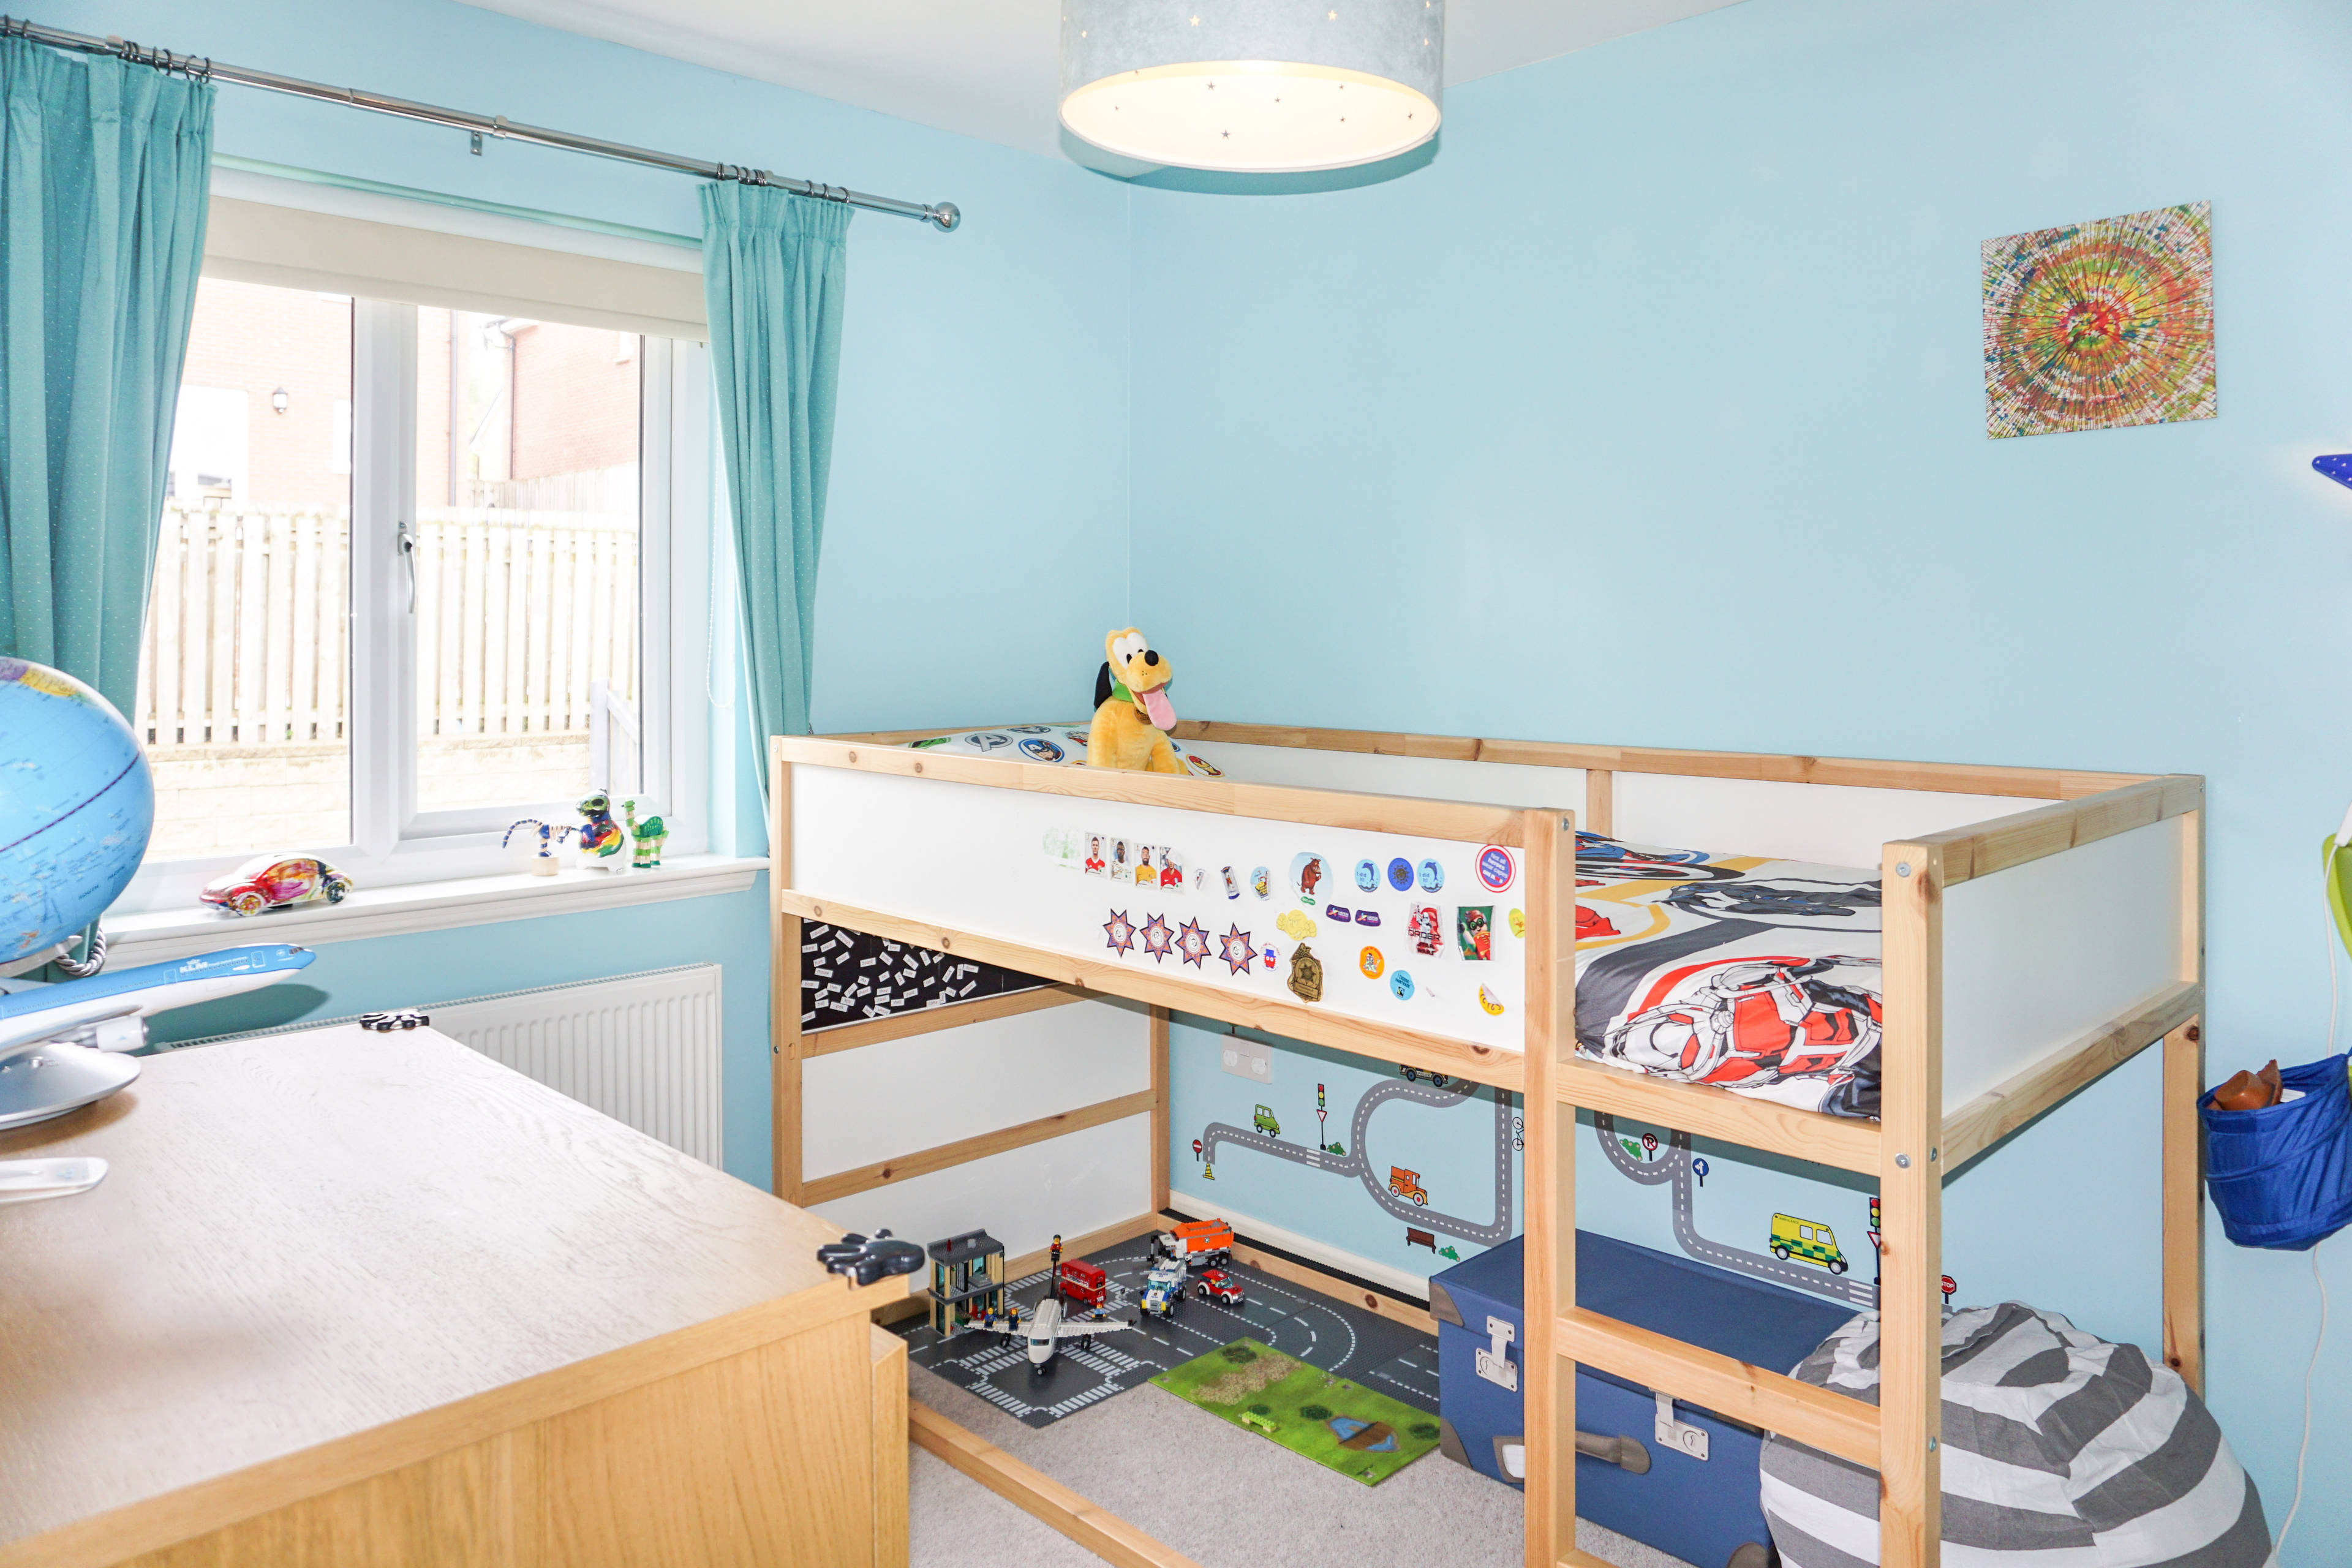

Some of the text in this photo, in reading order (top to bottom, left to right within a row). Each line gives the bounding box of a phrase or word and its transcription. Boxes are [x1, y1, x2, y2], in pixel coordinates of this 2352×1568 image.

[1408, 929, 1441, 941] ORDER
[1417, 947, 1436, 956] WARS
[179, 961, 208, 973] KLM
